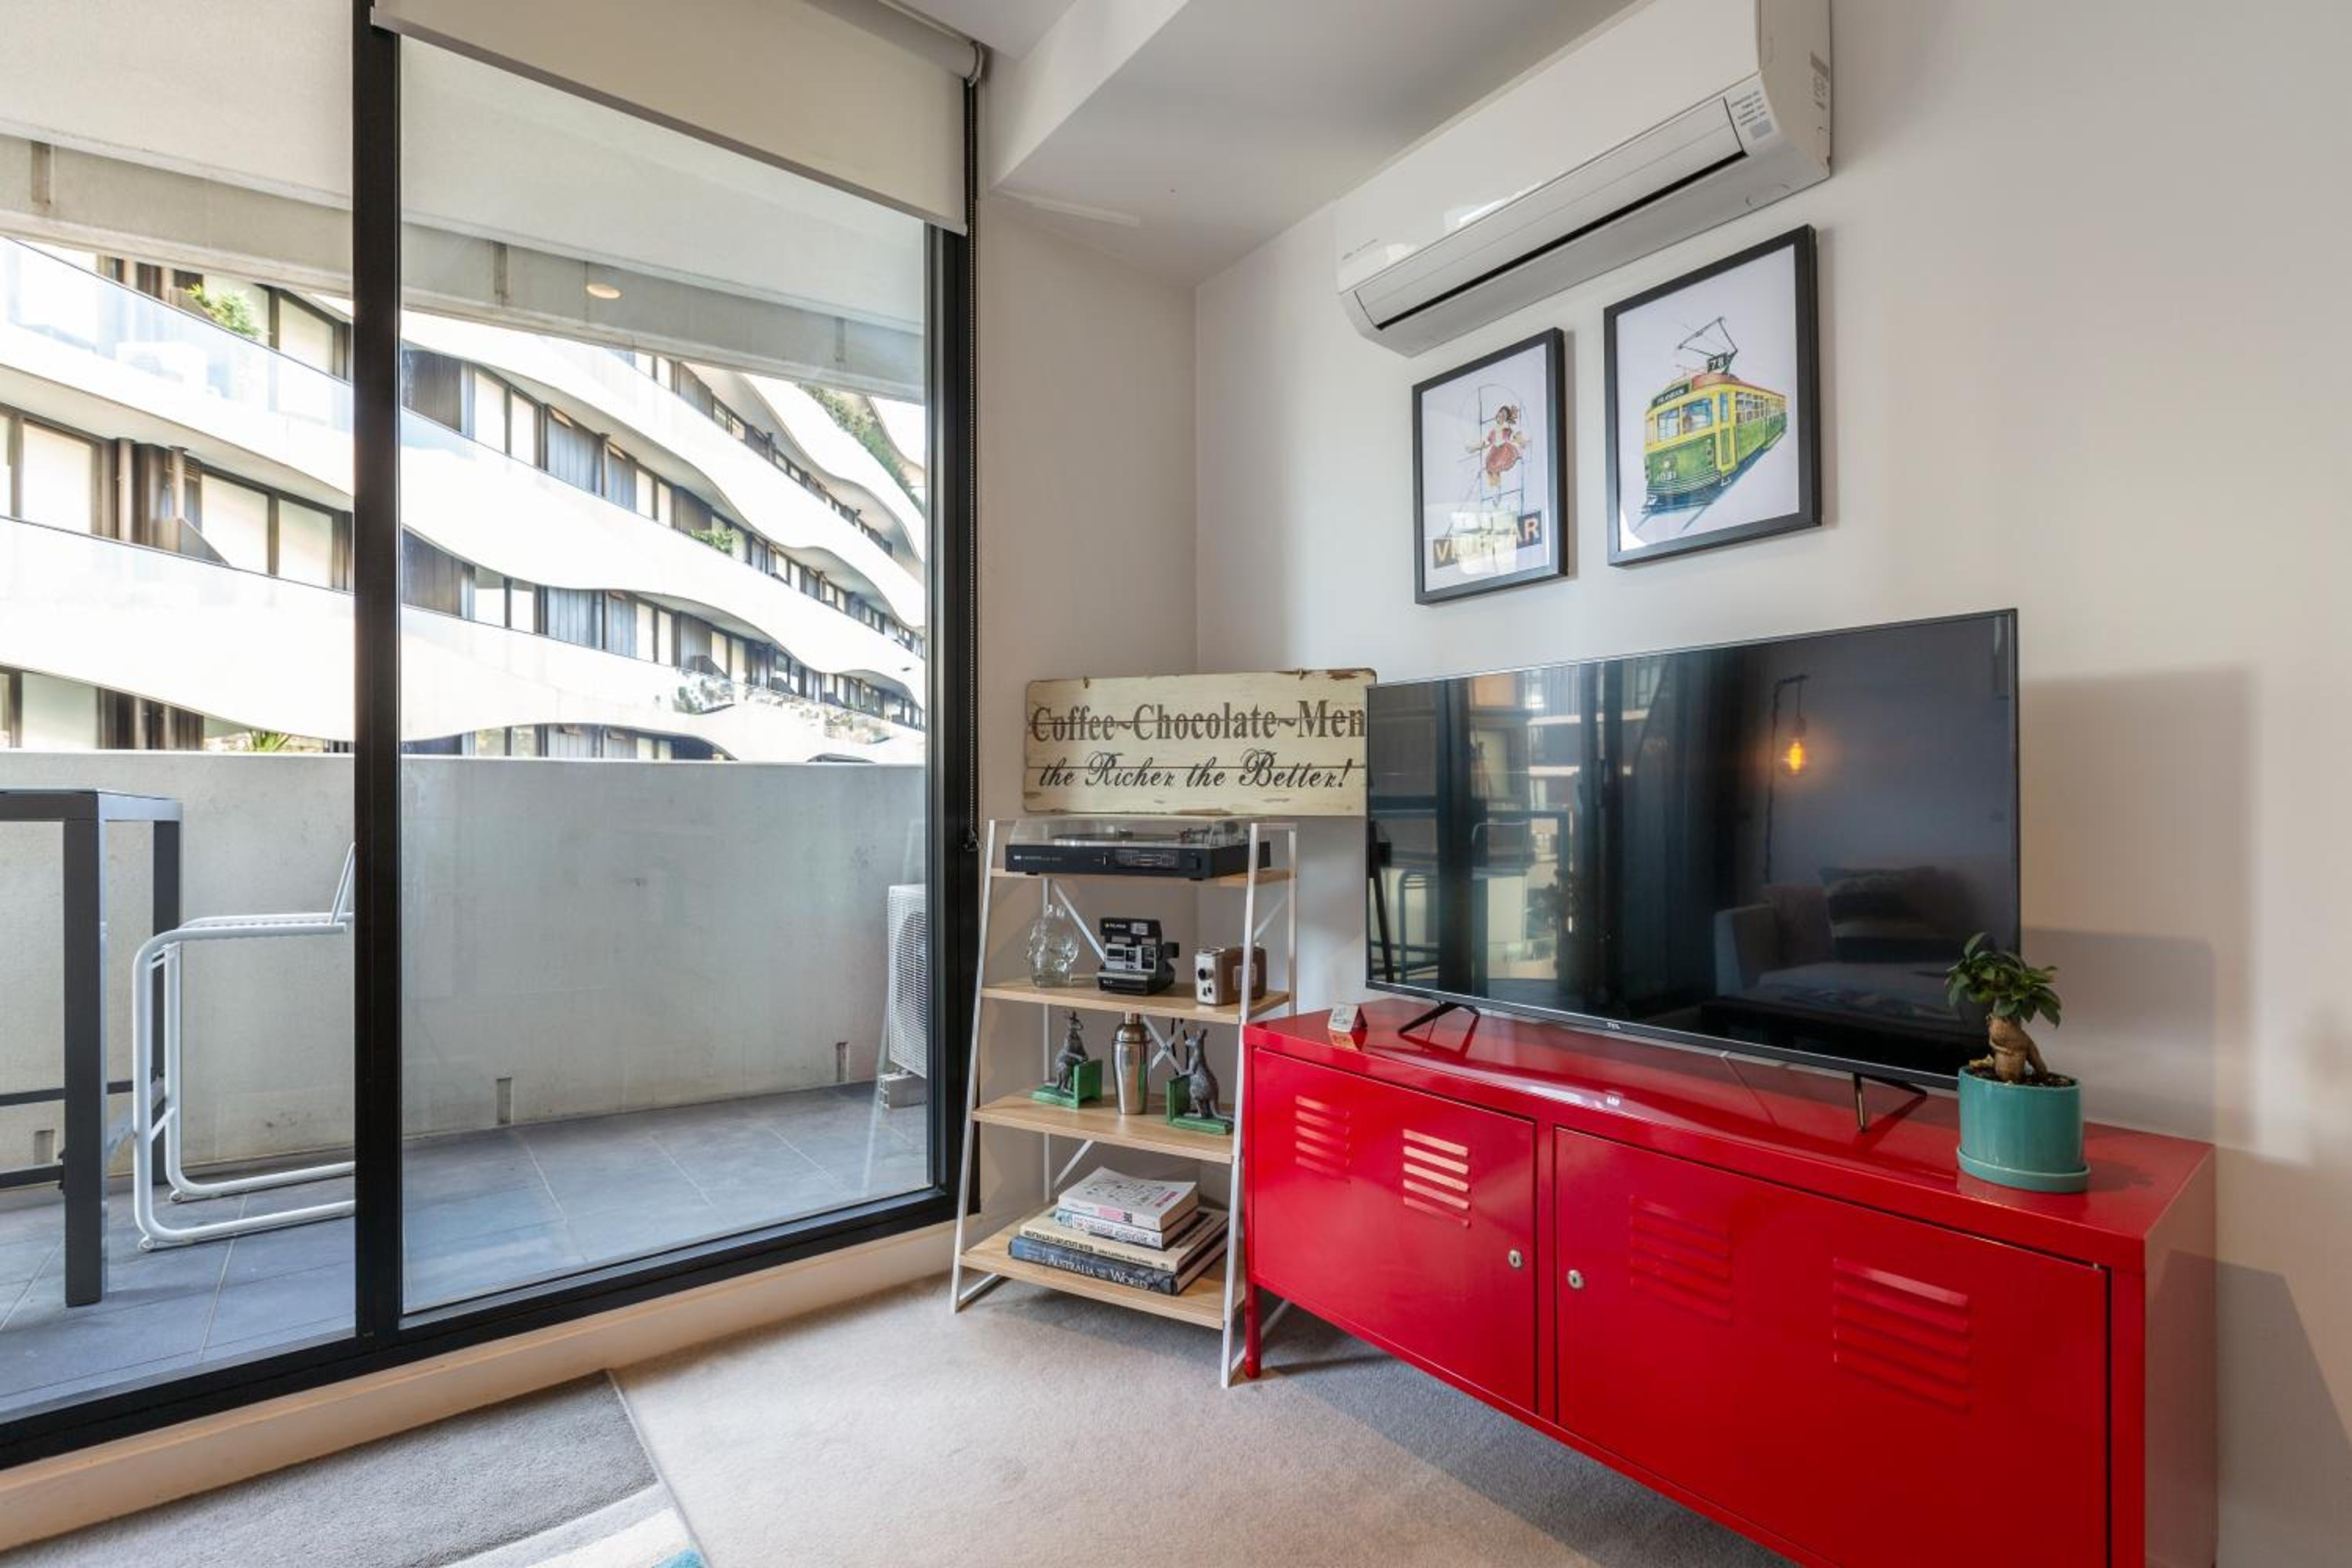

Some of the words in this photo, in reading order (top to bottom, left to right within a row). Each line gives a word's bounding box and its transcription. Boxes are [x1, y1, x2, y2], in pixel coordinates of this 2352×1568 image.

[1039, 758, 1074, 787] the
[1086, 751, 1174, 786] Richer
[1186, 757, 1226, 788] the
[1239, 747, 1352, 789] Better!
